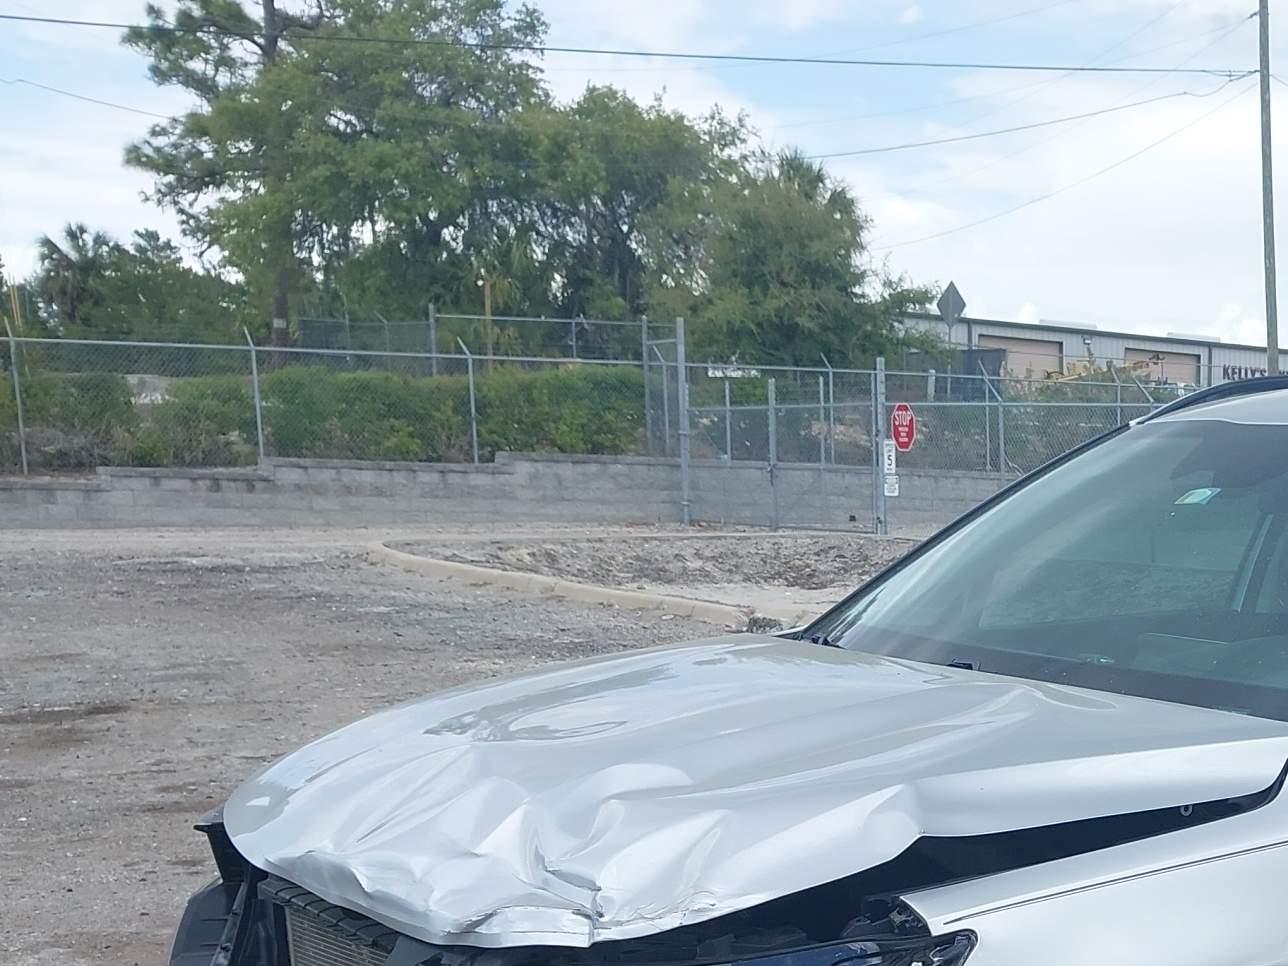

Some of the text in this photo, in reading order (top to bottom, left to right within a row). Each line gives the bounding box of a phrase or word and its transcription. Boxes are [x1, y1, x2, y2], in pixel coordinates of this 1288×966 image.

[1222, 364, 1267, 381] KELLY'S
[894, 409, 912, 426] STOP
[887, 454, 893, 467] 5
